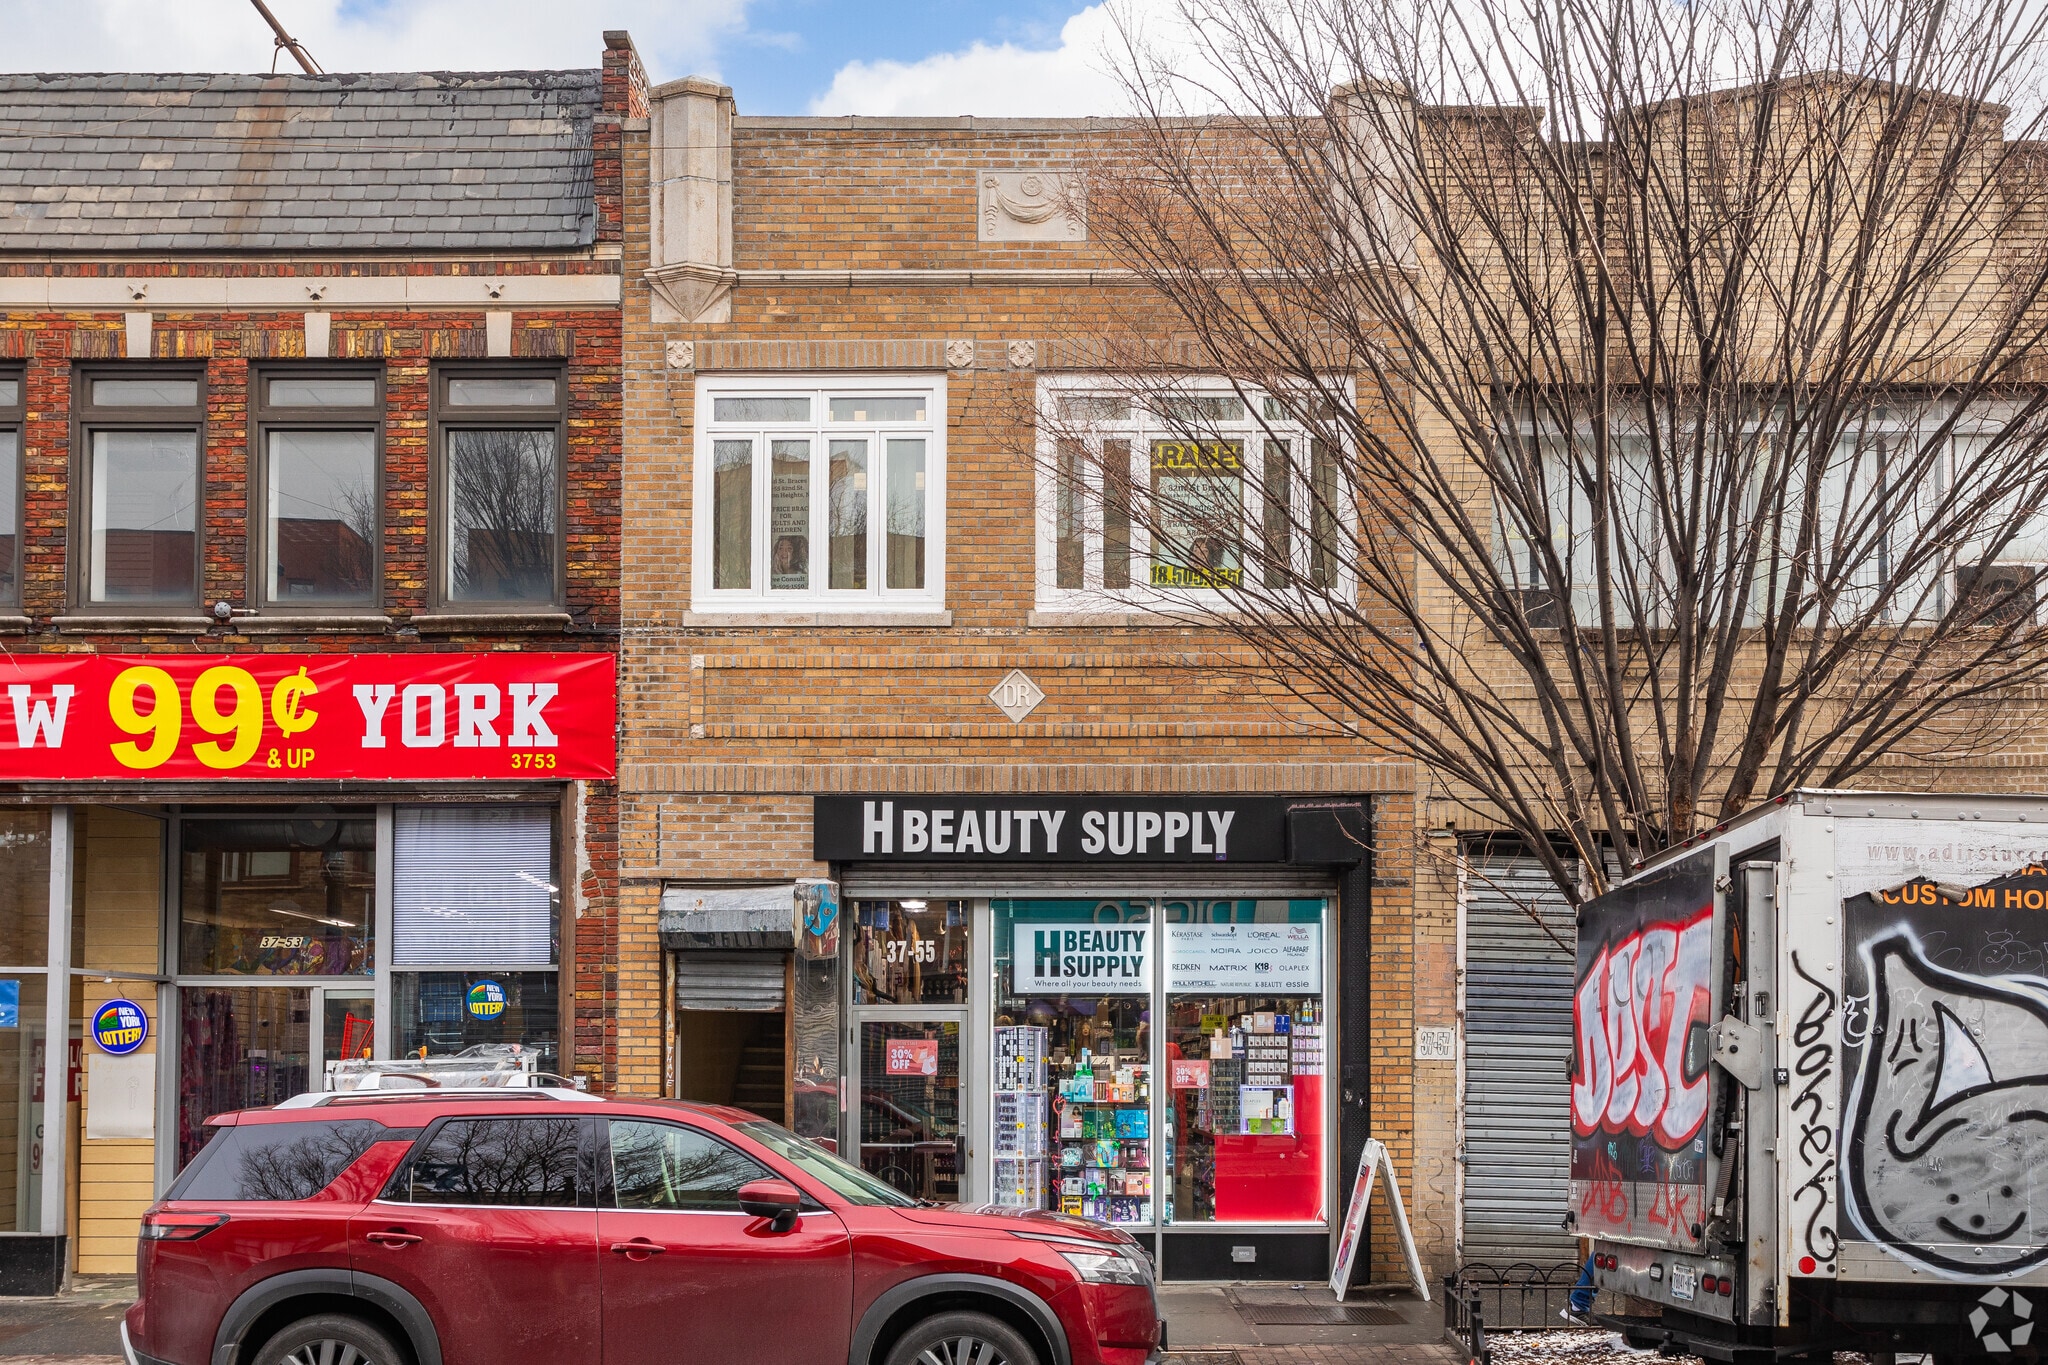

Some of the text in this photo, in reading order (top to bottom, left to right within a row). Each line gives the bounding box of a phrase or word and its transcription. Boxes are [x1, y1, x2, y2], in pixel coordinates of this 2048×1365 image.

[8, 684, 75, 748] W
[352, 683, 558, 748] YORK
[266, 748, 315, 769] & UP
[511, 754, 556, 769] 3753
[862, 801, 1236, 856] H BEAUTY SUPPLY
[2004, 889, 2048, 910] HO
[262, 937, 301, 947] 37-53
[886, 940, 935, 963] 37-55
[1034, 930, 1146, 977] H BEAUTY
[1063, 956, 1144, 978] SUPPLY
[1255, 962, 1270, 970] K18
[486, 984, 500, 992] NEW
[1092, 980, 1117, 988] beauty
[487, 992, 503, 1002] YORK
[118, 1007, 136, 1016] NEW
[469, 1001, 504, 1015] LOTTERY
[120, 1016, 141, 1028] YORK
[99, 1027, 142, 1045] LOTTERY
[1421, 1032, 1450, 1055] 37-57
[890, 1049, 912, 1059] 30%
[892, 1060, 910, 1069] OFF
[1176, 1067, 1191, 1075] 30%
